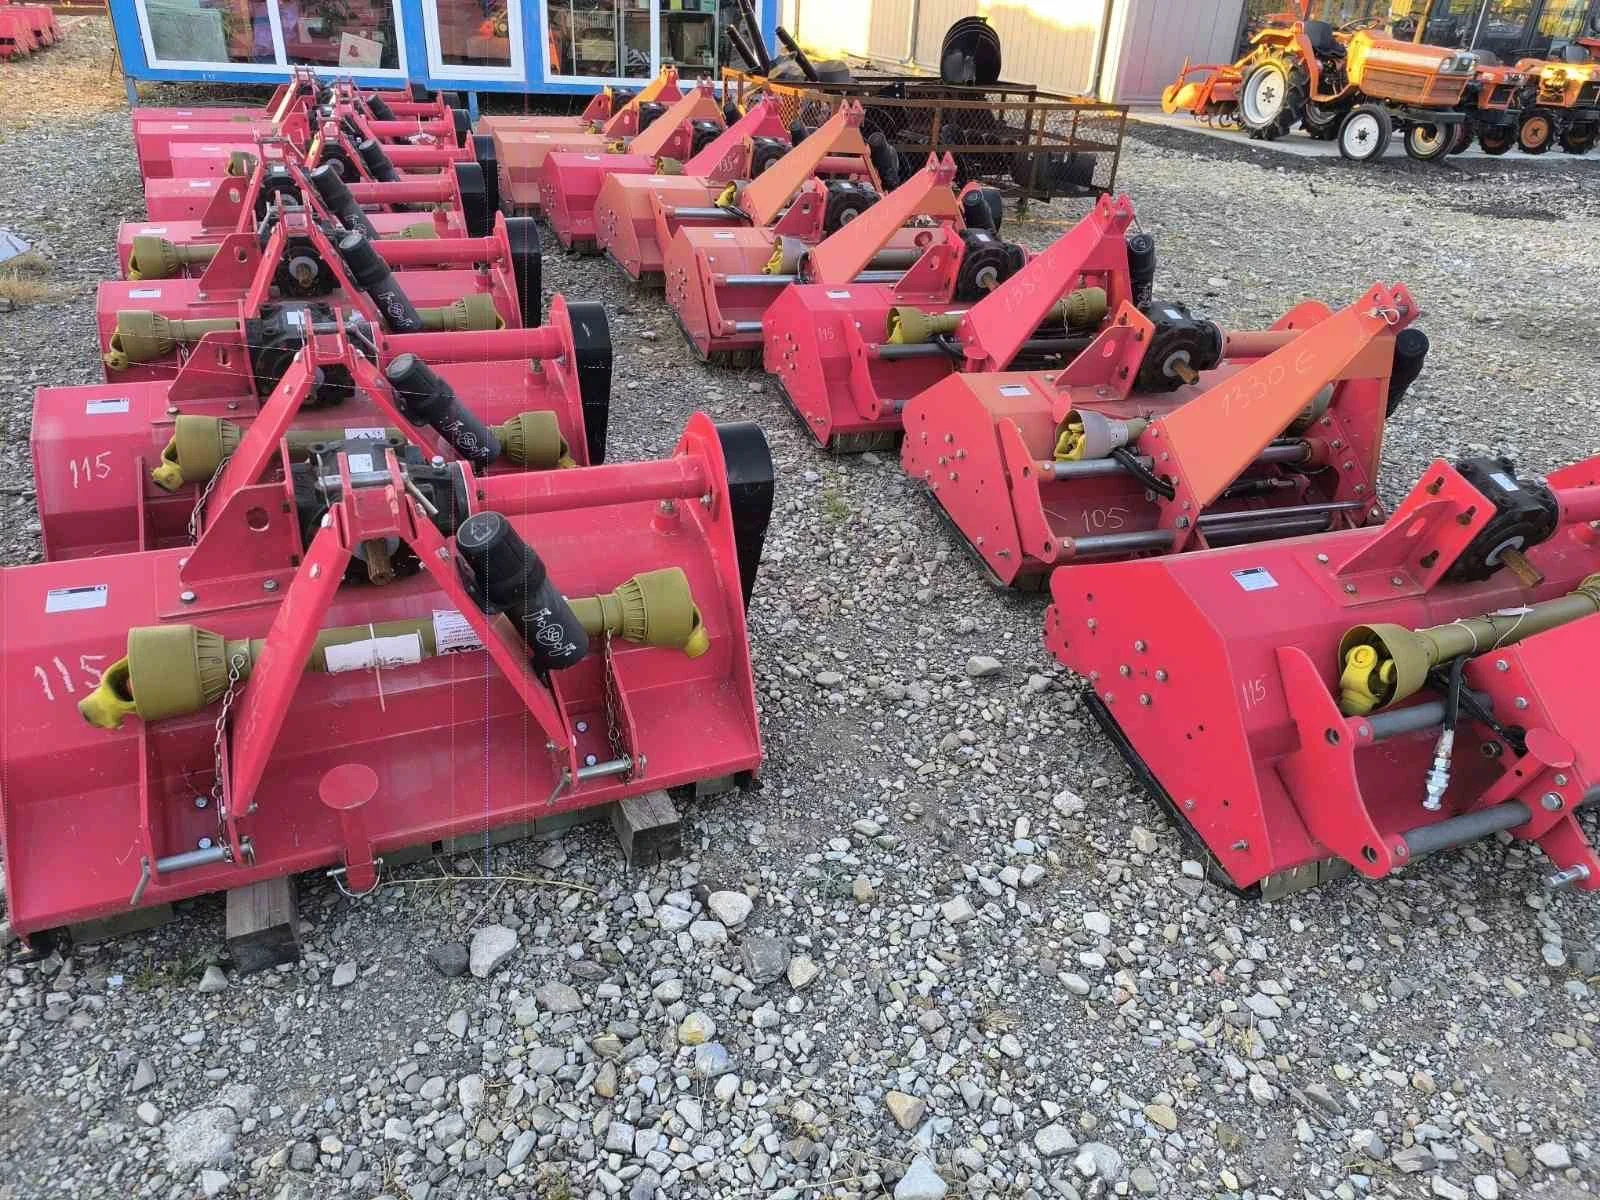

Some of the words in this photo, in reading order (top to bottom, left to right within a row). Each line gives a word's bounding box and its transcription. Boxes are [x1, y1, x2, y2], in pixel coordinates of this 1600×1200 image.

[1221, 365, 1285, 417] 1330
[69, 450, 112, 489] 115
[1080, 506, 1129, 533] 105
[33, 654, 107, 701] 115
[1241, 673, 1268, 712] 115
